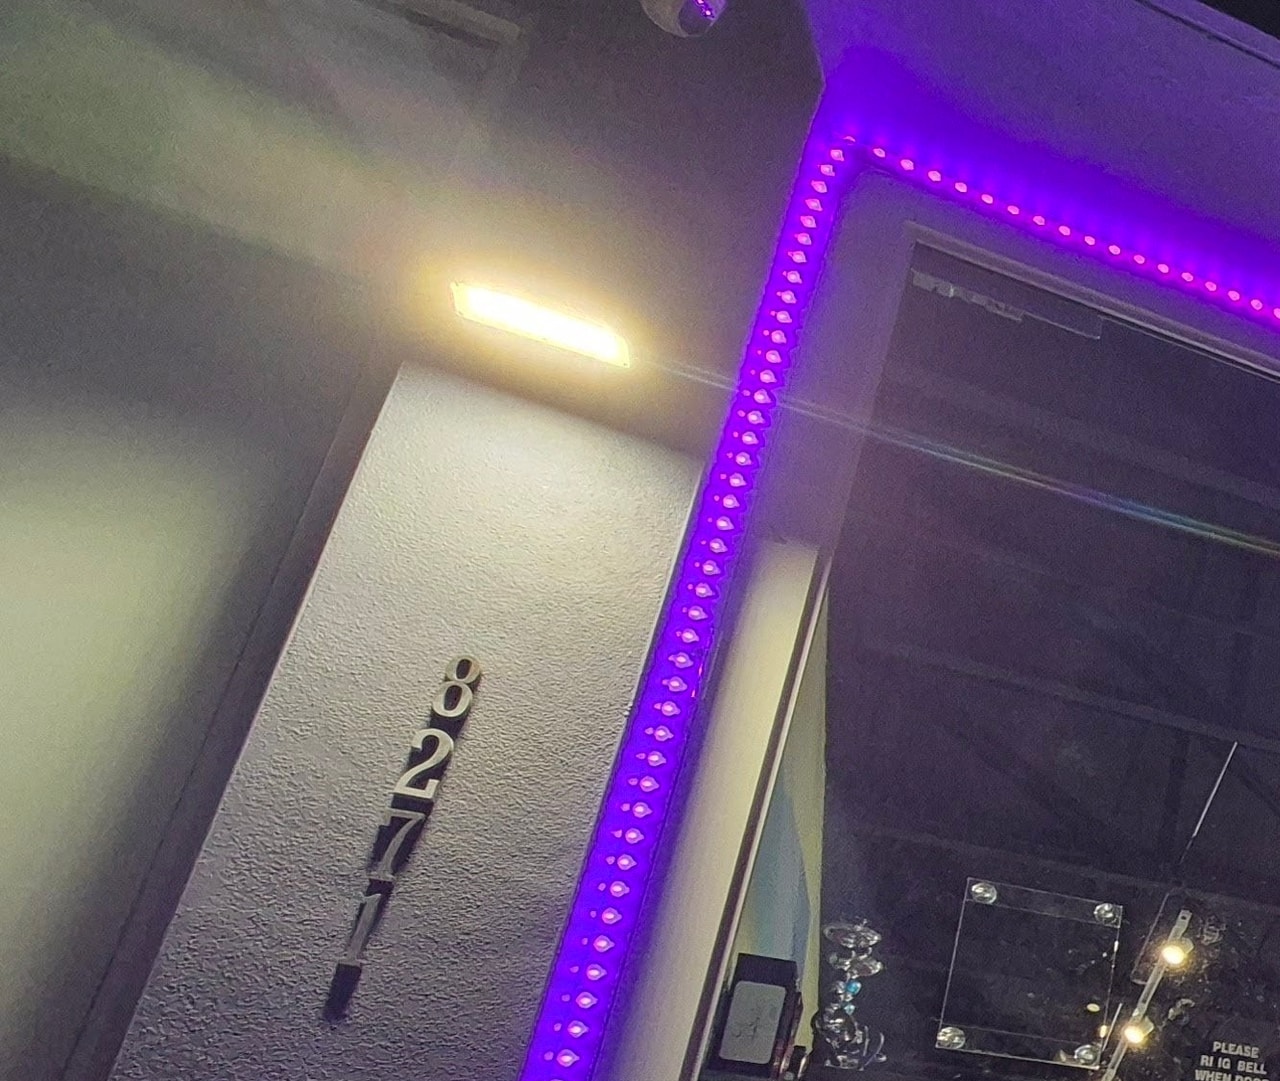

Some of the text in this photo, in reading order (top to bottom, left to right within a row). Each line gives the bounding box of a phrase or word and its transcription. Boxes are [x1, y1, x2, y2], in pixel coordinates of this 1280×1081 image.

[343, 654, 482, 968] 8271
[1213, 1041, 1260, 1058] PLEASE
[1237, 1060, 1267, 1075] BELL
